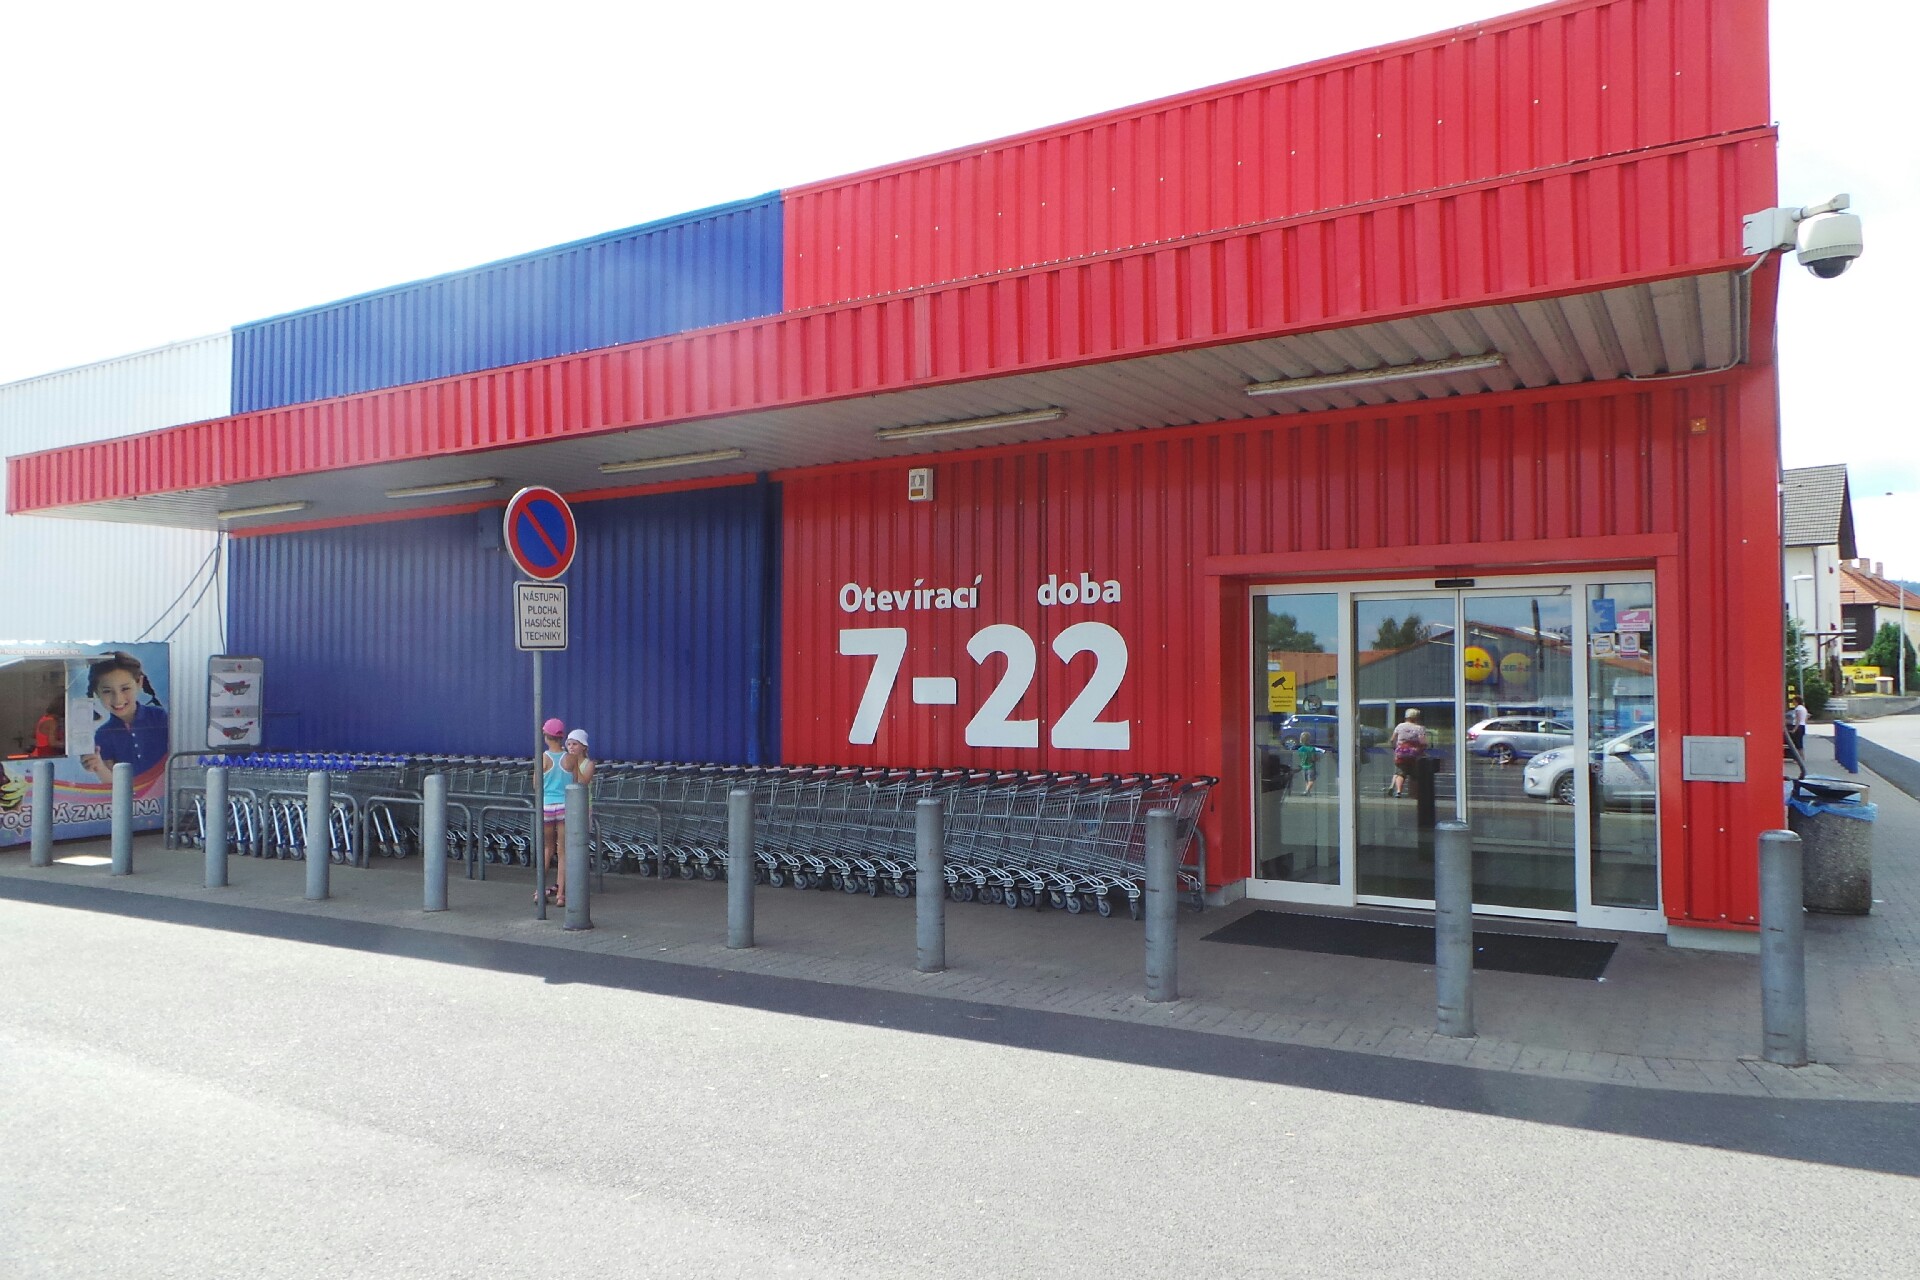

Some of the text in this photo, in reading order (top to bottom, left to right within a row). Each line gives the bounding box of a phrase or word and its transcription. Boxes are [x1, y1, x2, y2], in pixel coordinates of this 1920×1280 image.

[523, 590, 562, 602] NÁSTUPNÍ
[839, 572, 1122, 613] Otevírací doba
[527, 605, 558, 615] PLOCHA
[524, 617, 561, 628] HASIČSKÉ
[524, 631, 562, 641] TECHNIKY
[839, 621, 1130, 750] 7-22
[71, 798, 161, 823] ZMRINA
